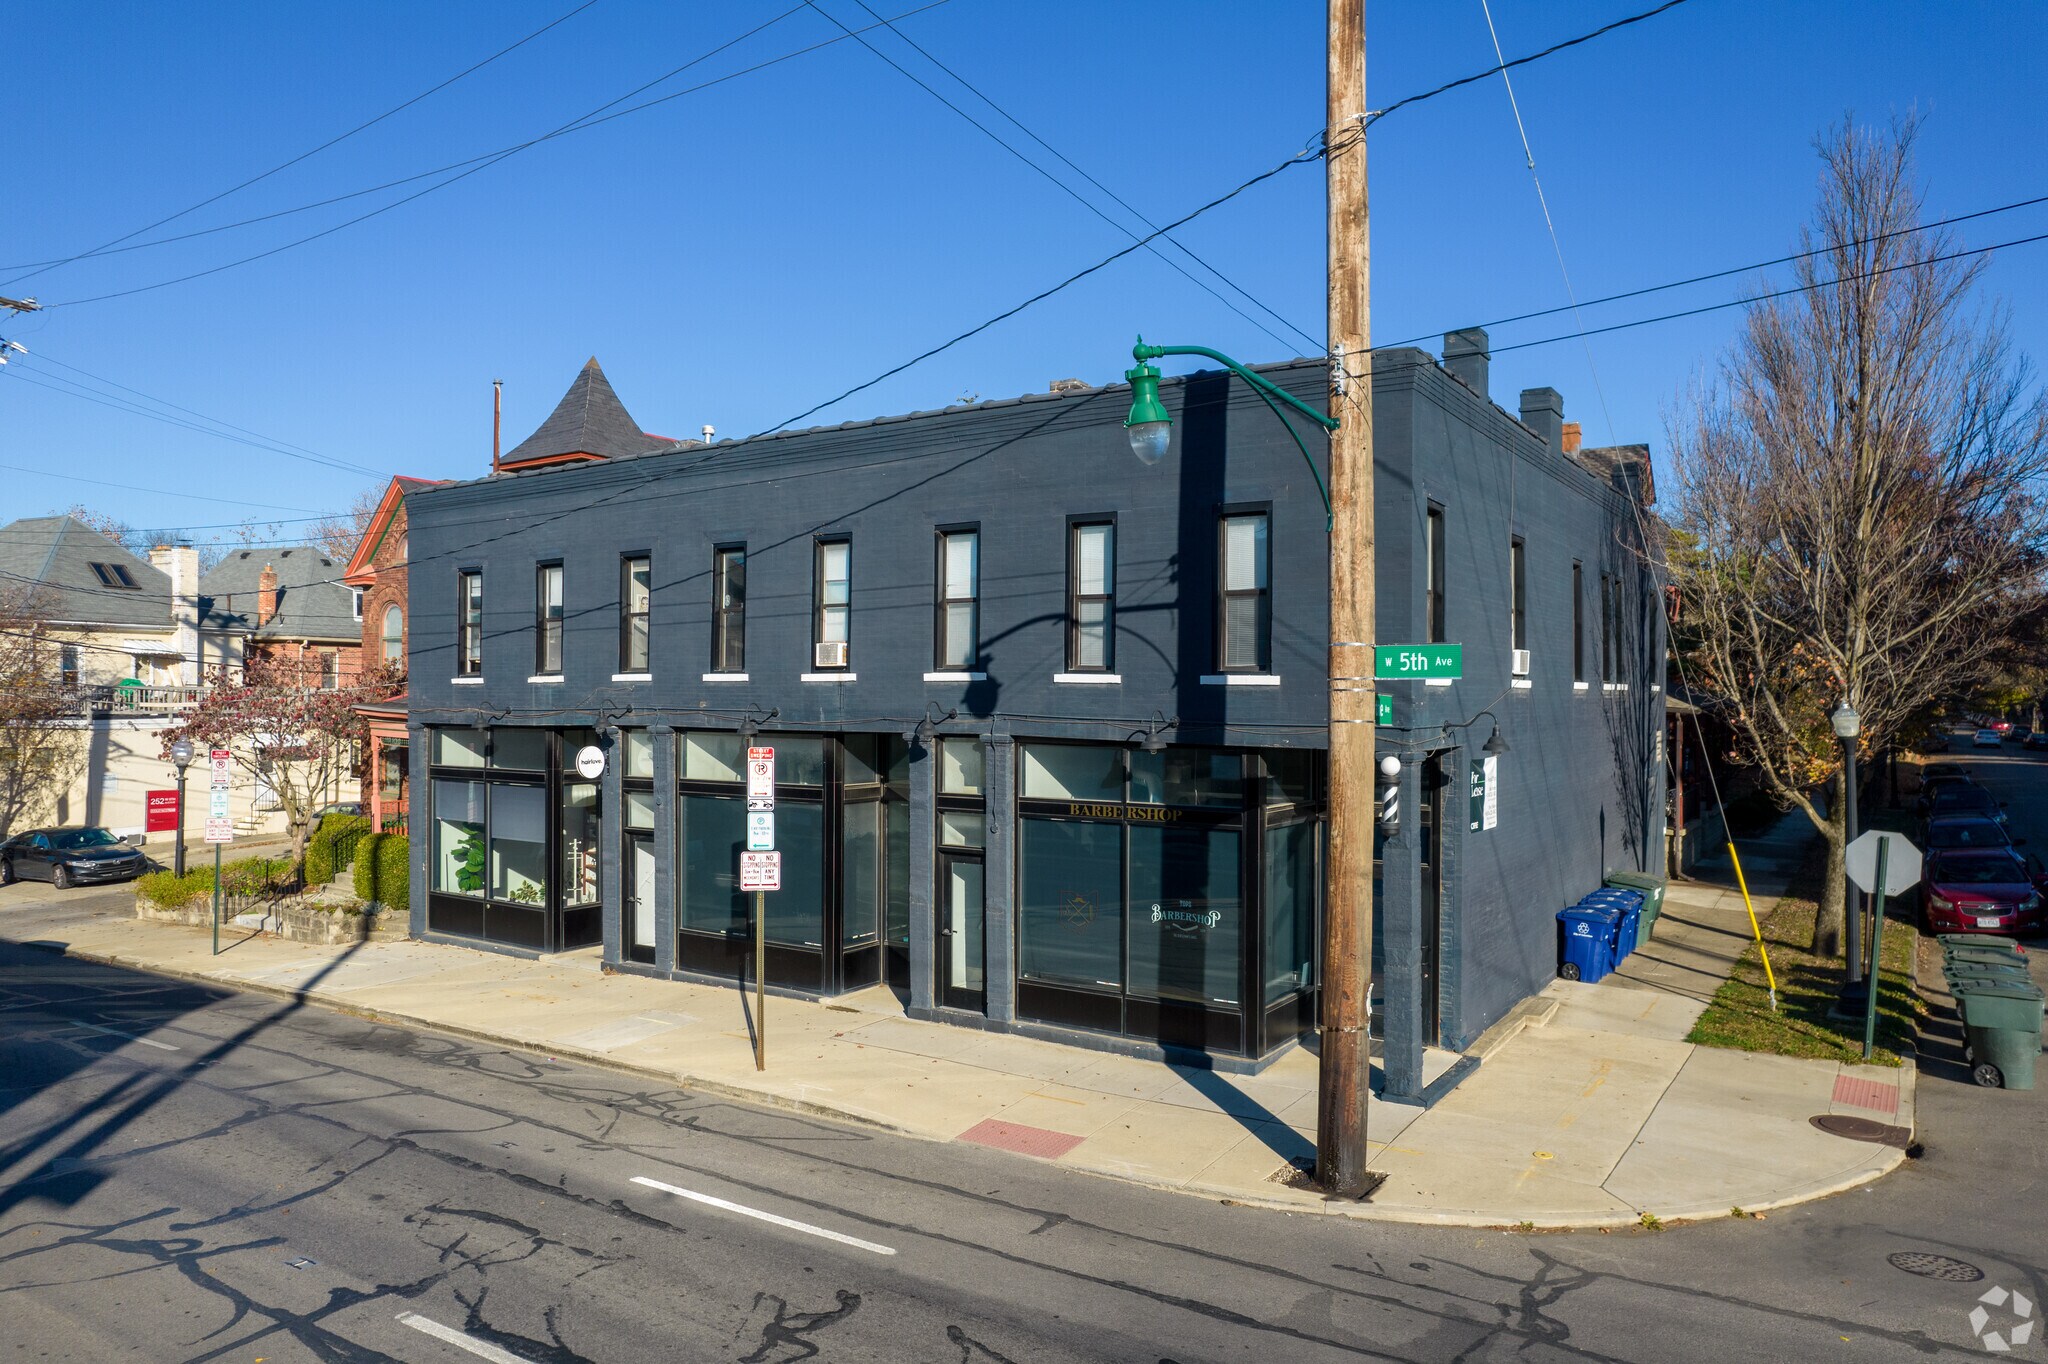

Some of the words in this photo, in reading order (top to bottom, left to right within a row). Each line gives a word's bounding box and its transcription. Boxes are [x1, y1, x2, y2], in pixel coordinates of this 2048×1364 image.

[1385, 657, 1393, 667] W
[1400, 652, 1428, 671] 5th
[1435, 656, 1453, 666] Ave
[150, 797, 165, 806] 252
[1070, 803, 1183, 822] BARBERSHOP
